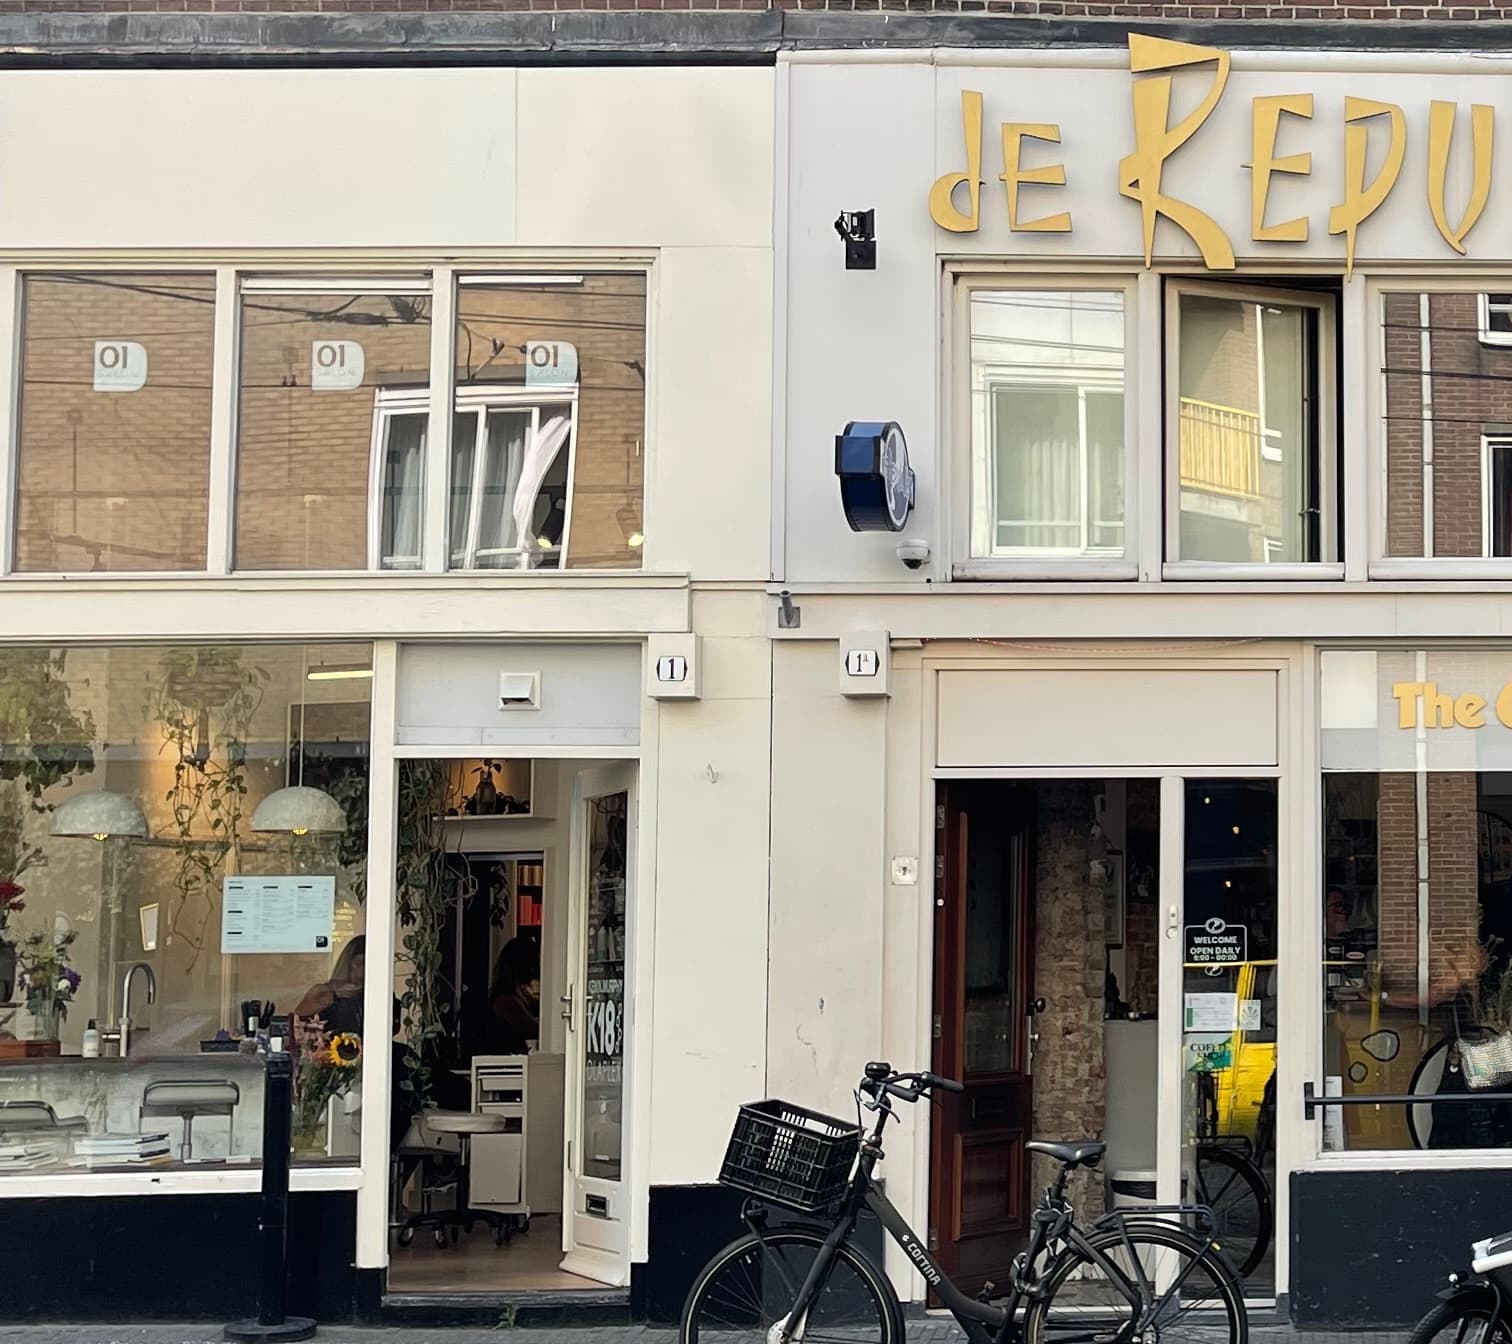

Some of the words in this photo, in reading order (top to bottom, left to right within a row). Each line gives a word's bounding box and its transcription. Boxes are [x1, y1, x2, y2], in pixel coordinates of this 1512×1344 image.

[667, 657, 677, 680] 1
[1393, 680, 1487, 730] The
[1190, 946, 1214, 955] OPEN
[1215, 946, 1241, 955] DAILY
[1193, 935, 1238, 944] WELCOME
[586, 999, 615, 1057] K18
